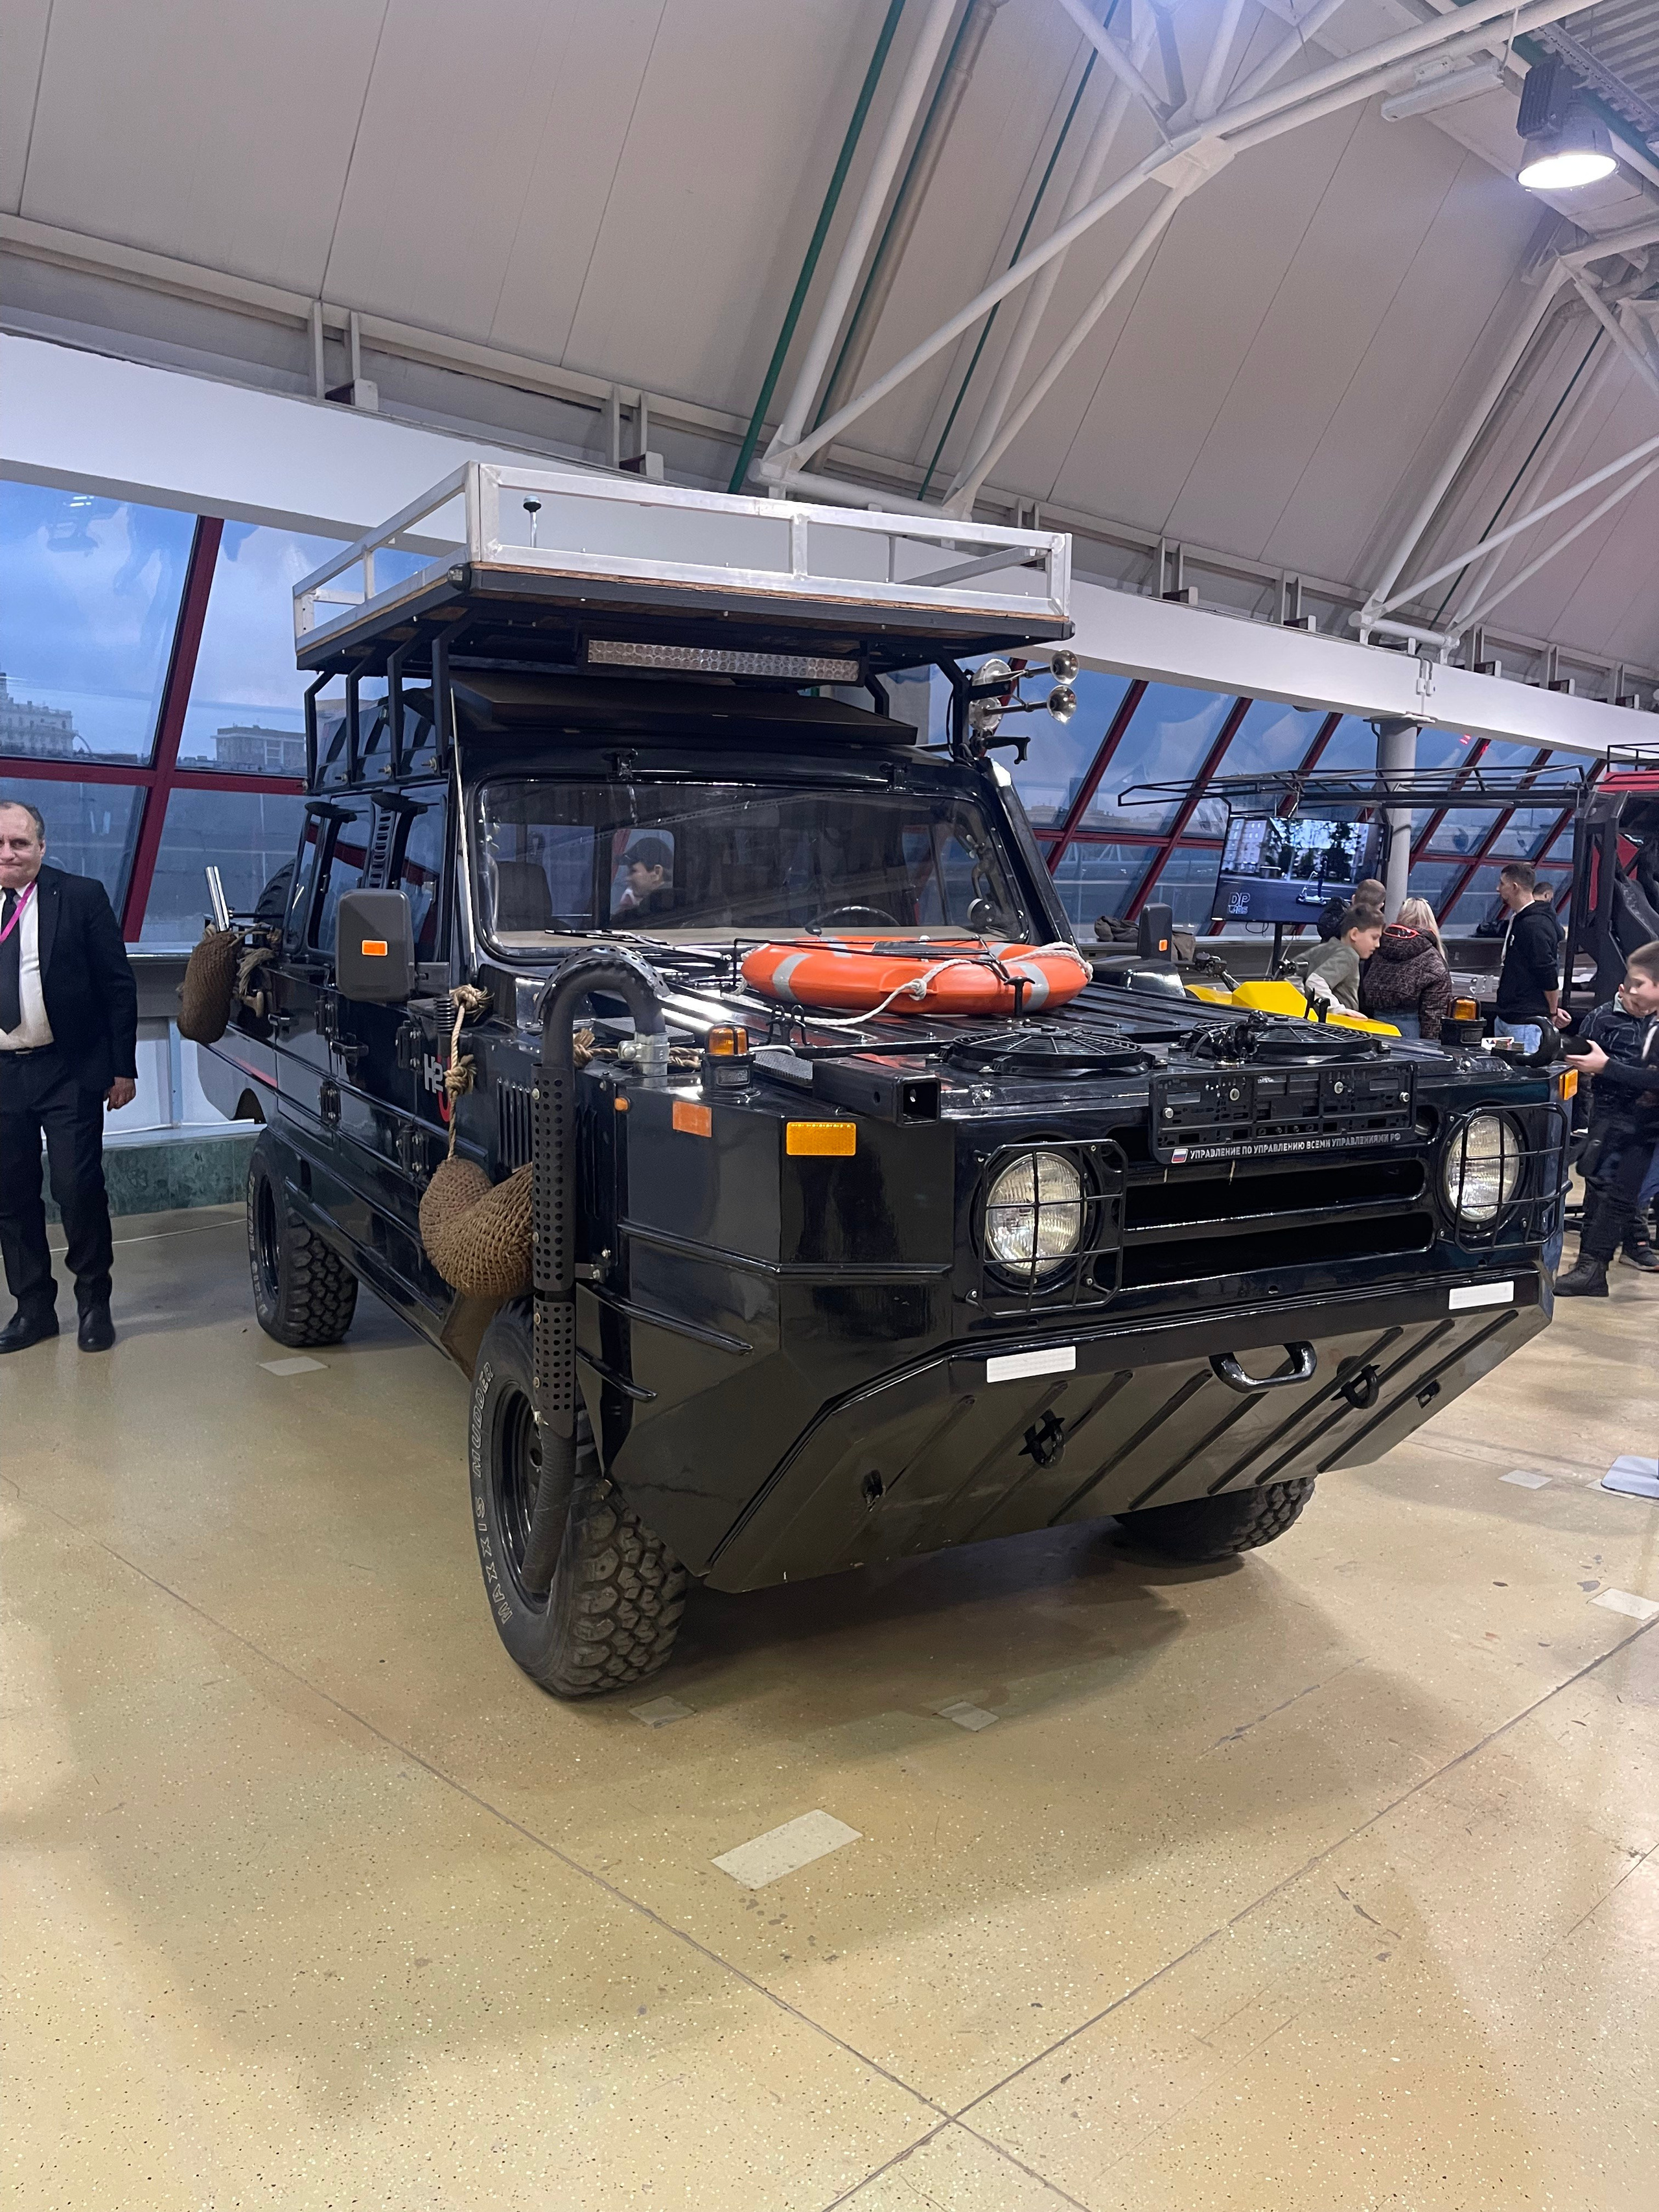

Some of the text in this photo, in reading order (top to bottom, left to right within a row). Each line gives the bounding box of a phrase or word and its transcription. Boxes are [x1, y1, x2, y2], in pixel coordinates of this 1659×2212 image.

[1229, 892, 1251, 907] DP
[1190, 1132, 1401, 1159] УПРАВЛЕНИЕ ПО УПРАВЛЕНИЮ ВСЕМИ УПРАВЛЕНИЯМИ РФ
[471, 1361, 513, 1625] MAXXIS MUDDER
